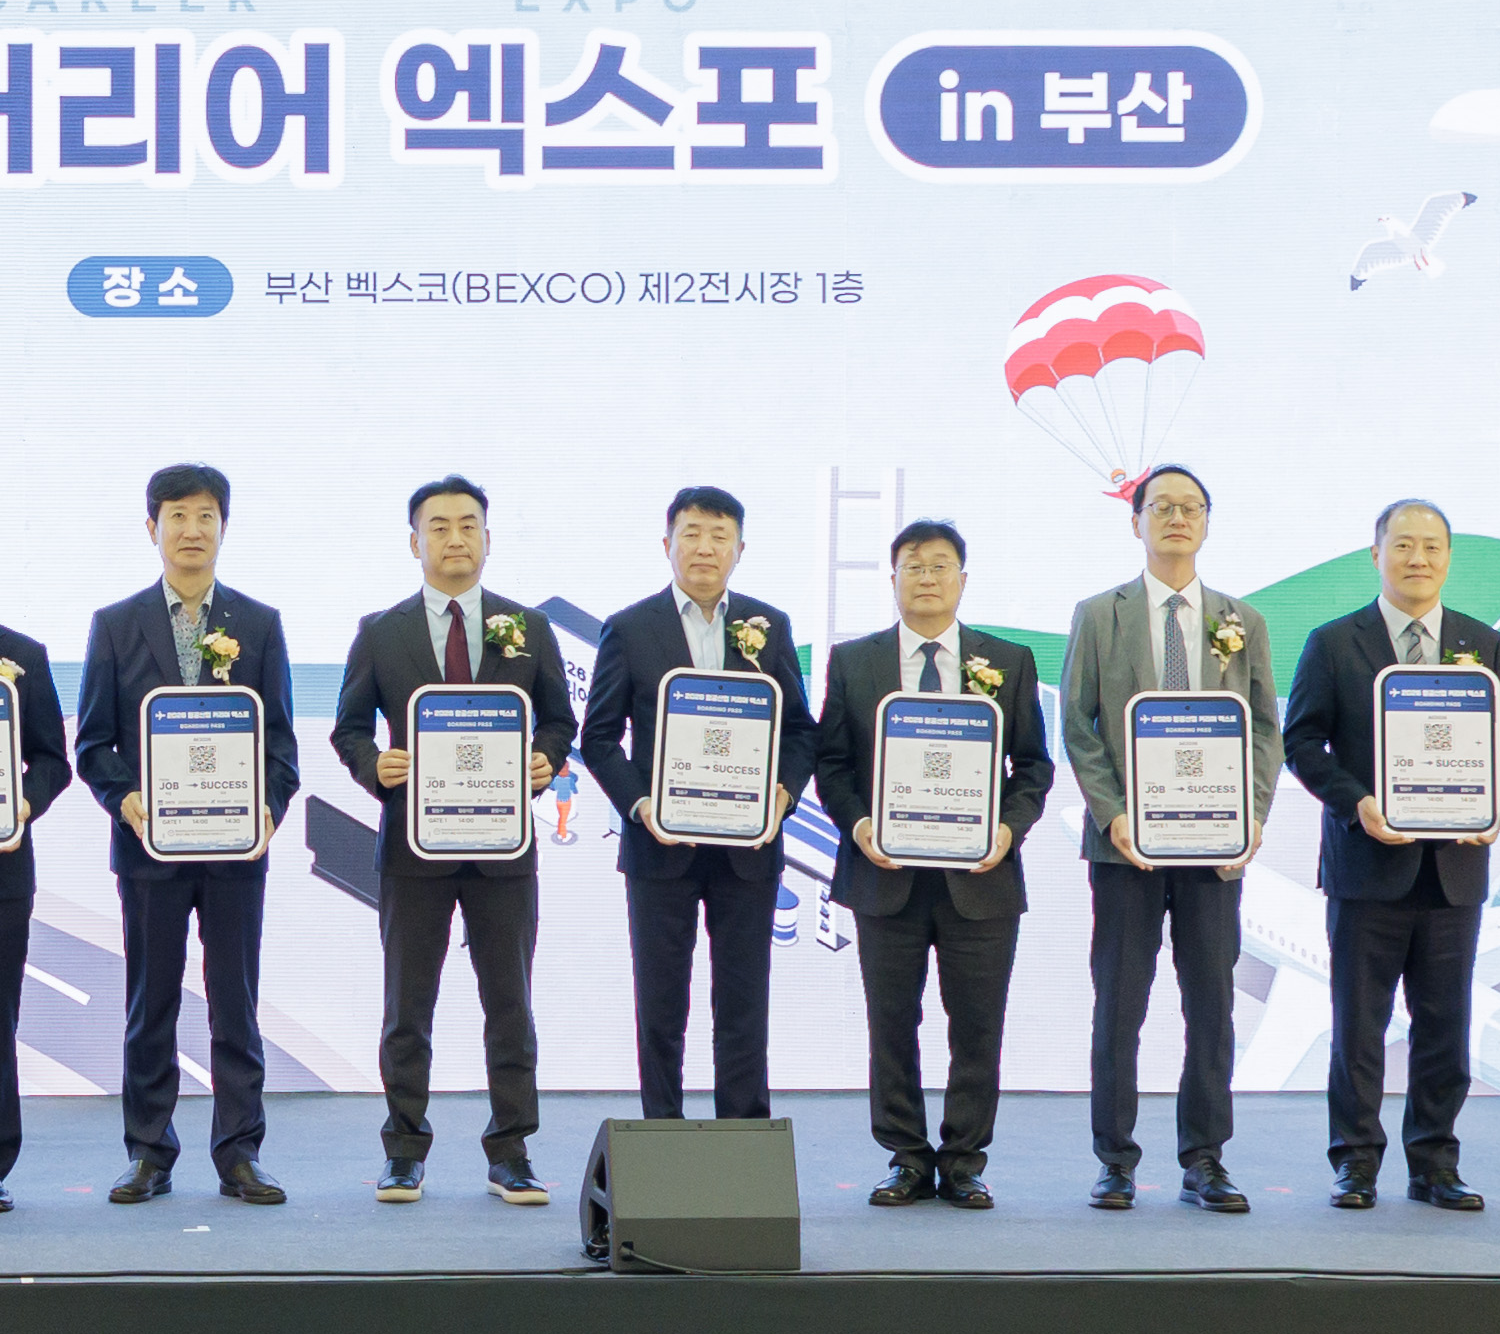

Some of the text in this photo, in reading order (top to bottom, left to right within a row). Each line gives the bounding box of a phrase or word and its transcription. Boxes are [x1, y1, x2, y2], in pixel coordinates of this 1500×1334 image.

[394, 41, 825, 177] 엑스포
[939, 70, 1014, 143] in
[1039, 70, 1193, 144] 부산
[263, 269, 333, 308] 부산
[345, 269, 627, 309] 벡스코(BEXCO)
[637, 269, 806, 308] 제2전시장
[815, 269, 865, 308] 1층
[671, 761, 761, 775] JOB SUCCESS
[1393, 758, 1484, 768] JOB SUCCESS
[159, 781, 248, 790] JOB SUCCESS
[425, 780, 515, 788] JOB SUCCESS
[1144, 785, 1236, 793] JOB SUCCESS
[891, 785, 983, 797] JOB SUCCESS
